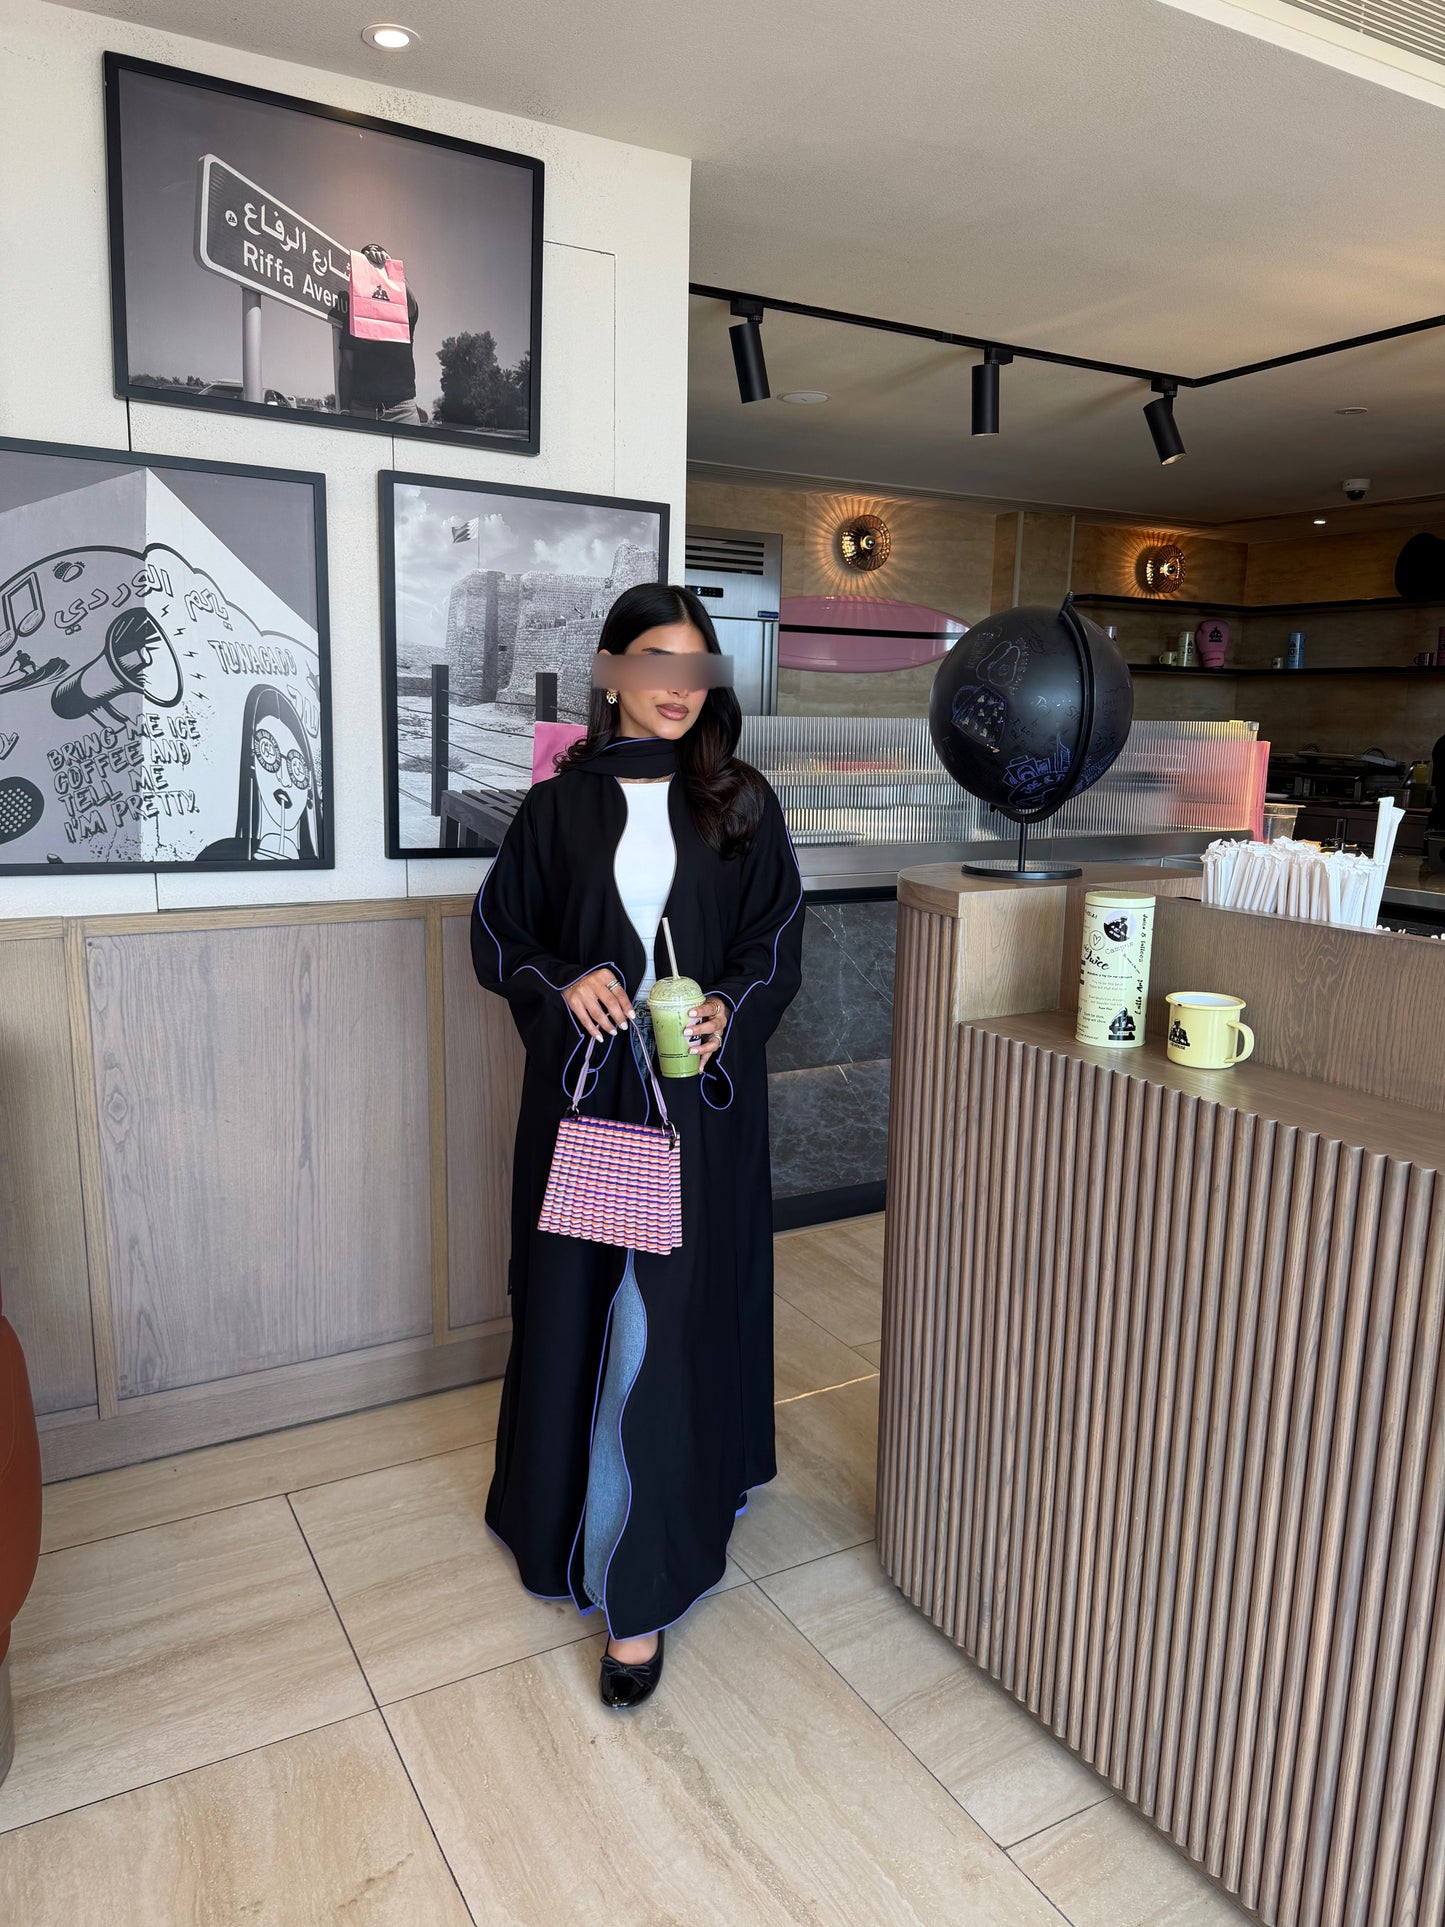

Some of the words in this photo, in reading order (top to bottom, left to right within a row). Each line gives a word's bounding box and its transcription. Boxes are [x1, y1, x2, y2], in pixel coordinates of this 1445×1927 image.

[244, 202, 308, 254] الرفاع
[243, 241, 294, 288] Riffa
[302, 274, 349, 314] Avenu
[54, 564, 174, 635] الوردي
[207, 640, 298, 676] TUNACADO
[47, 727, 118, 771] BRING
[125, 713, 164, 741] ME
[167, 716, 200, 739] ICE
[53, 742, 144, 794] COFFEE
[150, 740, 191, 764] AND
[58, 780, 124, 818] TELL
[128, 765, 168, 793] ME
[64, 811, 108, 843] I'M
[1083, 951, 1110, 971] Juice
